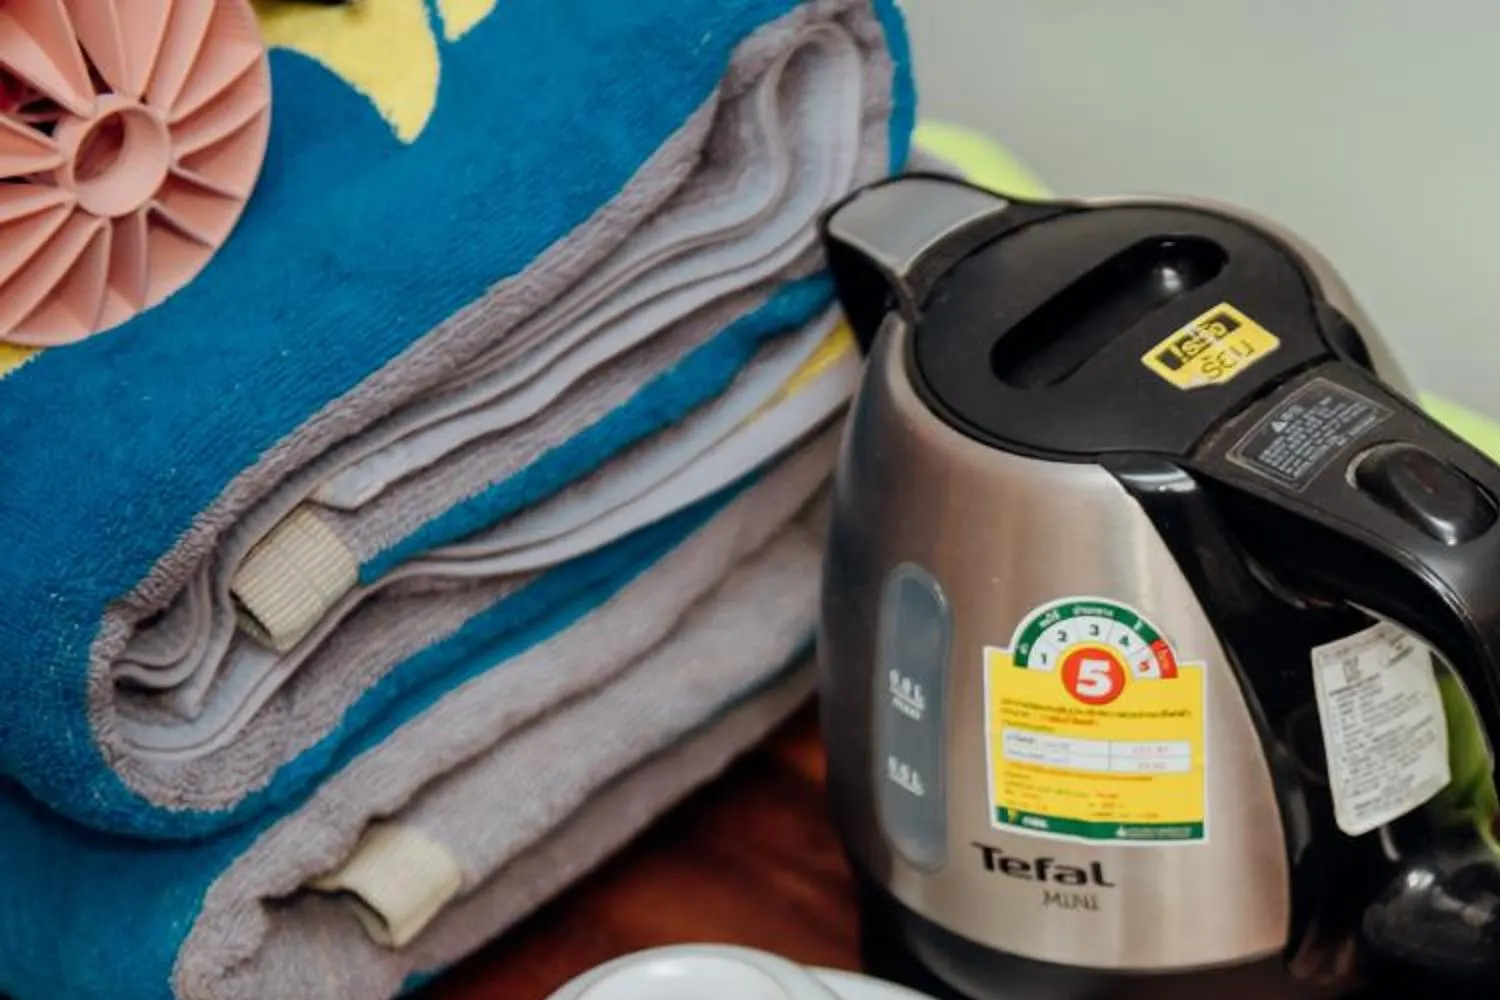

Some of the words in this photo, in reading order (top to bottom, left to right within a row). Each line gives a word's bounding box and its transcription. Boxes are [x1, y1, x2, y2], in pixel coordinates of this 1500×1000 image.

[1040, 652, 1047, 665] 1
[1057, 629, 1068, 643] 2
[1088, 623, 1100, 637] 3
[1118, 634, 1130, 648] 4
[1075, 659, 1113, 697] 5
[970, 841, 1116, 888] Tefal
